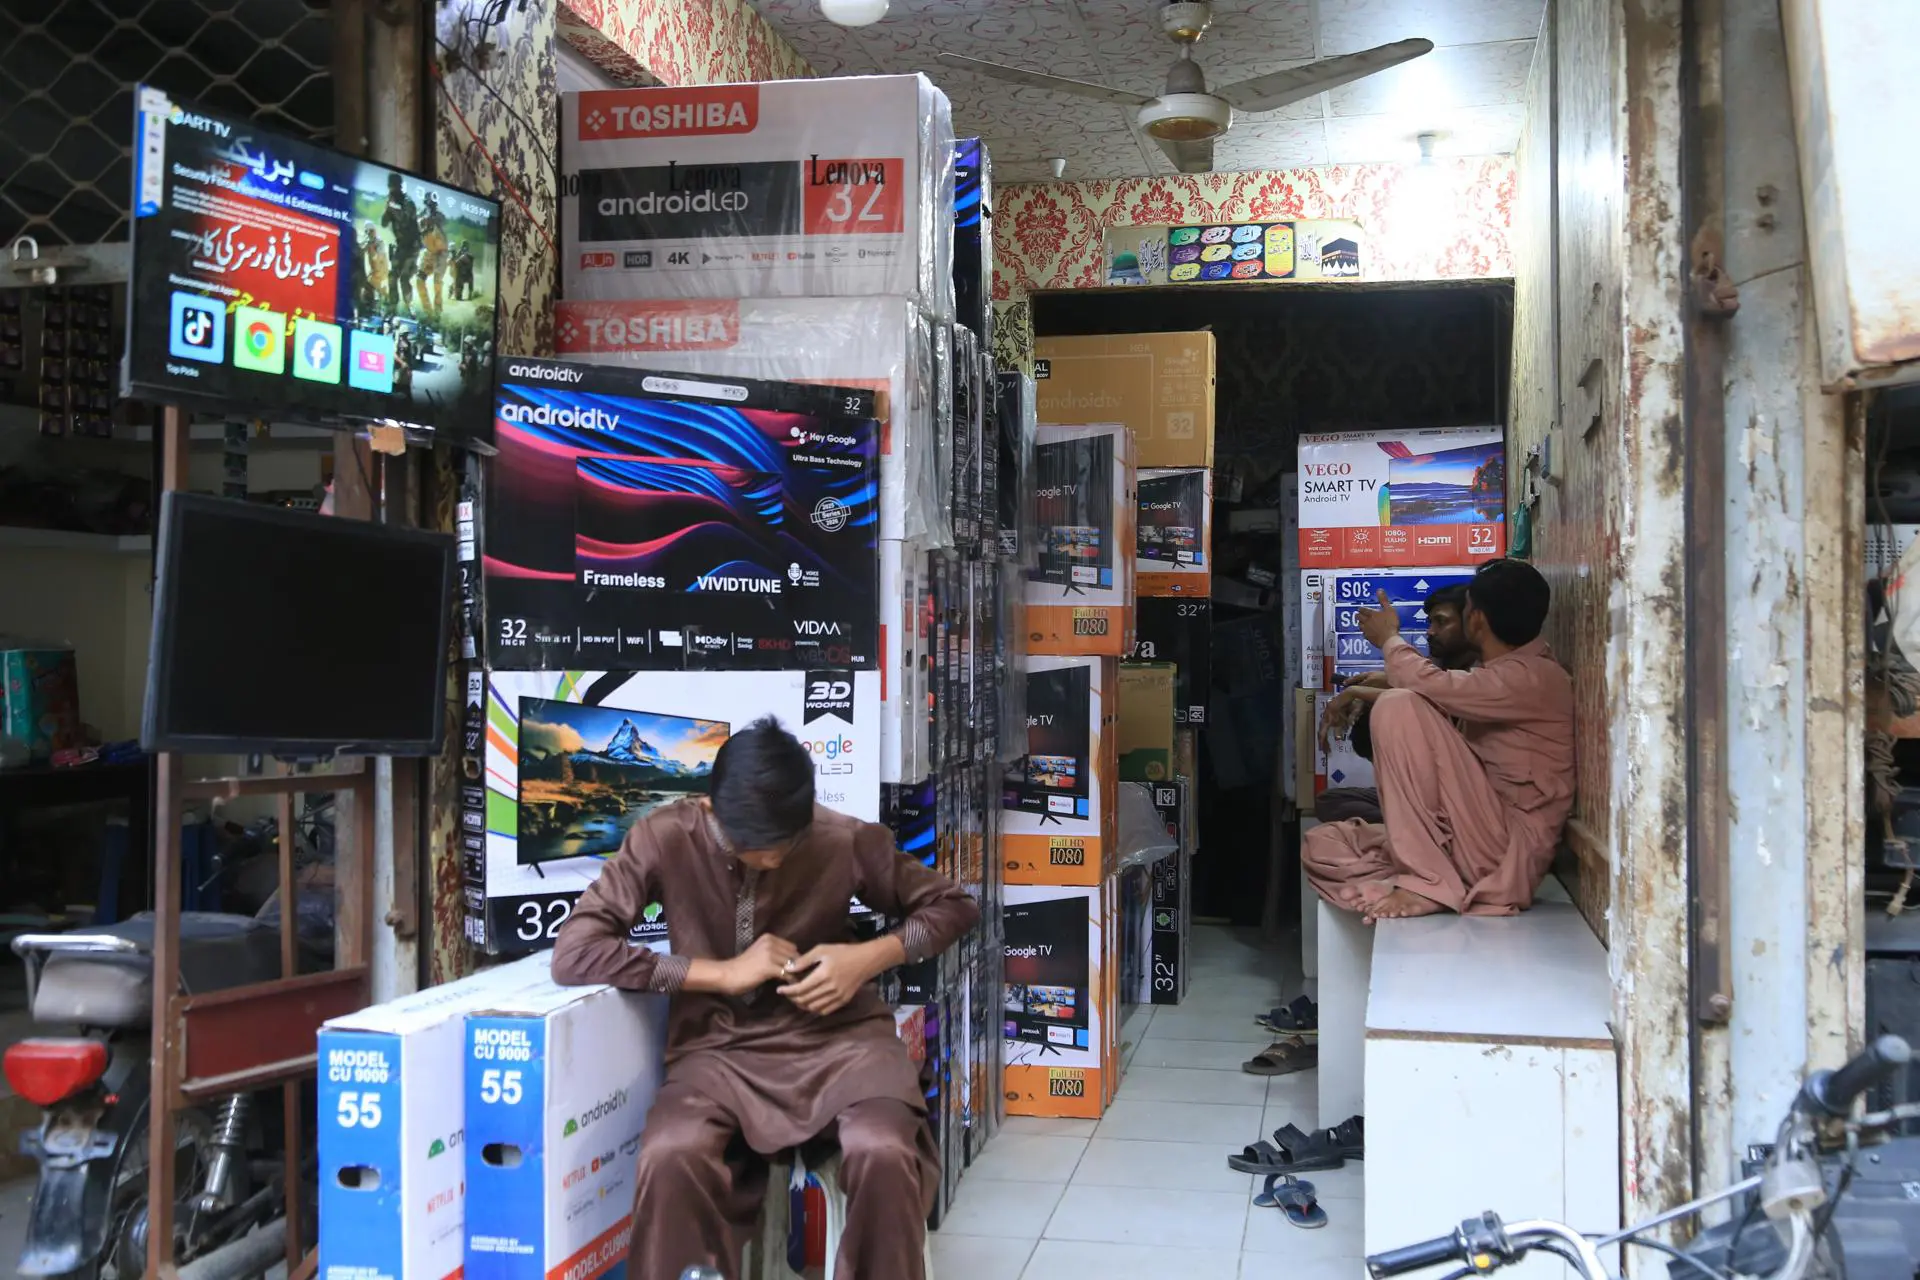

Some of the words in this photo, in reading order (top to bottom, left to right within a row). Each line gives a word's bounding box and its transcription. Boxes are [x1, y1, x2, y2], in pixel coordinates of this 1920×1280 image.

[668, 160, 742, 191] Lenova
[810, 154, 886, 187] Lenova
[826, 170, 885, 222] 32
[668, 251, 691, 265] 4K
[509, 364, 583, 383] androidtv
[844, 397, 861, 410] 32
[501, 403, 620, 431] androidtv
[810, 432, 826, 443] Hey
[826, 434, 857, 446] Google
[1304, 433, 1340, 443] VEGO
[792, 454, 809, 462] Ultra
[809, 455, 825, 464] Bass
[826, 457, 863, 468] Technology
[1304, 462, 1352, 476] VEGO
[1063, 485, 1078, 496] TV
[1304, 480, 1354, 493] SMART
[1358, 479, 1377, 491] TV
[1304, 494, 1337, 503] Android
[1340, 494, 1351, 502] TV
[1150, 502, 1173, 511] Google
[1172, 501, 1182, 509] TV
[821, 510, 841, 519] Series
[1385, 529, 1407, 537] 1080p
[1471, 528, 1493, 545] 32
[1417, 536, 1452, 545] HDMI
[583, 570, 666, 588] Frameless
[696, 575, 781, 593] VIVIDTUNE
[500, 618, 527, 639] 32
[1075, 618, 1107, 634] 1080
[500, 639, 526, 647] INCH
[626, 636, 644, 645] WiFi
[705, 636, 728, 647] Dolby
[850, 655, 865, 663] HUB
[808, 681, 852, 700] 3D
[1040, 714, 1053, 726] TV
[802, 733, 853, 759] oogle
[1051, 838, 1066, 847] Full
[1069, 839, 1084, 847] HD
[1051, 848, 1083, 865] 1080
[1039, 944, 1052, 956] TV
[906, 985, 921, 993] HUB
[474, 1028, 532, 1047] MODEL
[329, 1049, 390, 1068] MODEL
[474, 1044, 495, 1060] CU
[498, 1046, 530, 1062] 9000
[329, 1066, 352, 1082] CU
[354, 1067, 389, 1084] 9000
[1051, 1069, 1067, 1078] Full
[1069, 1069, 1084, 1079] HD
[480, 1069, 522, 1105] 55
[1051, 1079, 1083, 1096] 1080
[336, 1091, 382, 1129] 55
[581, 1088, 628, 1128] androidtv
